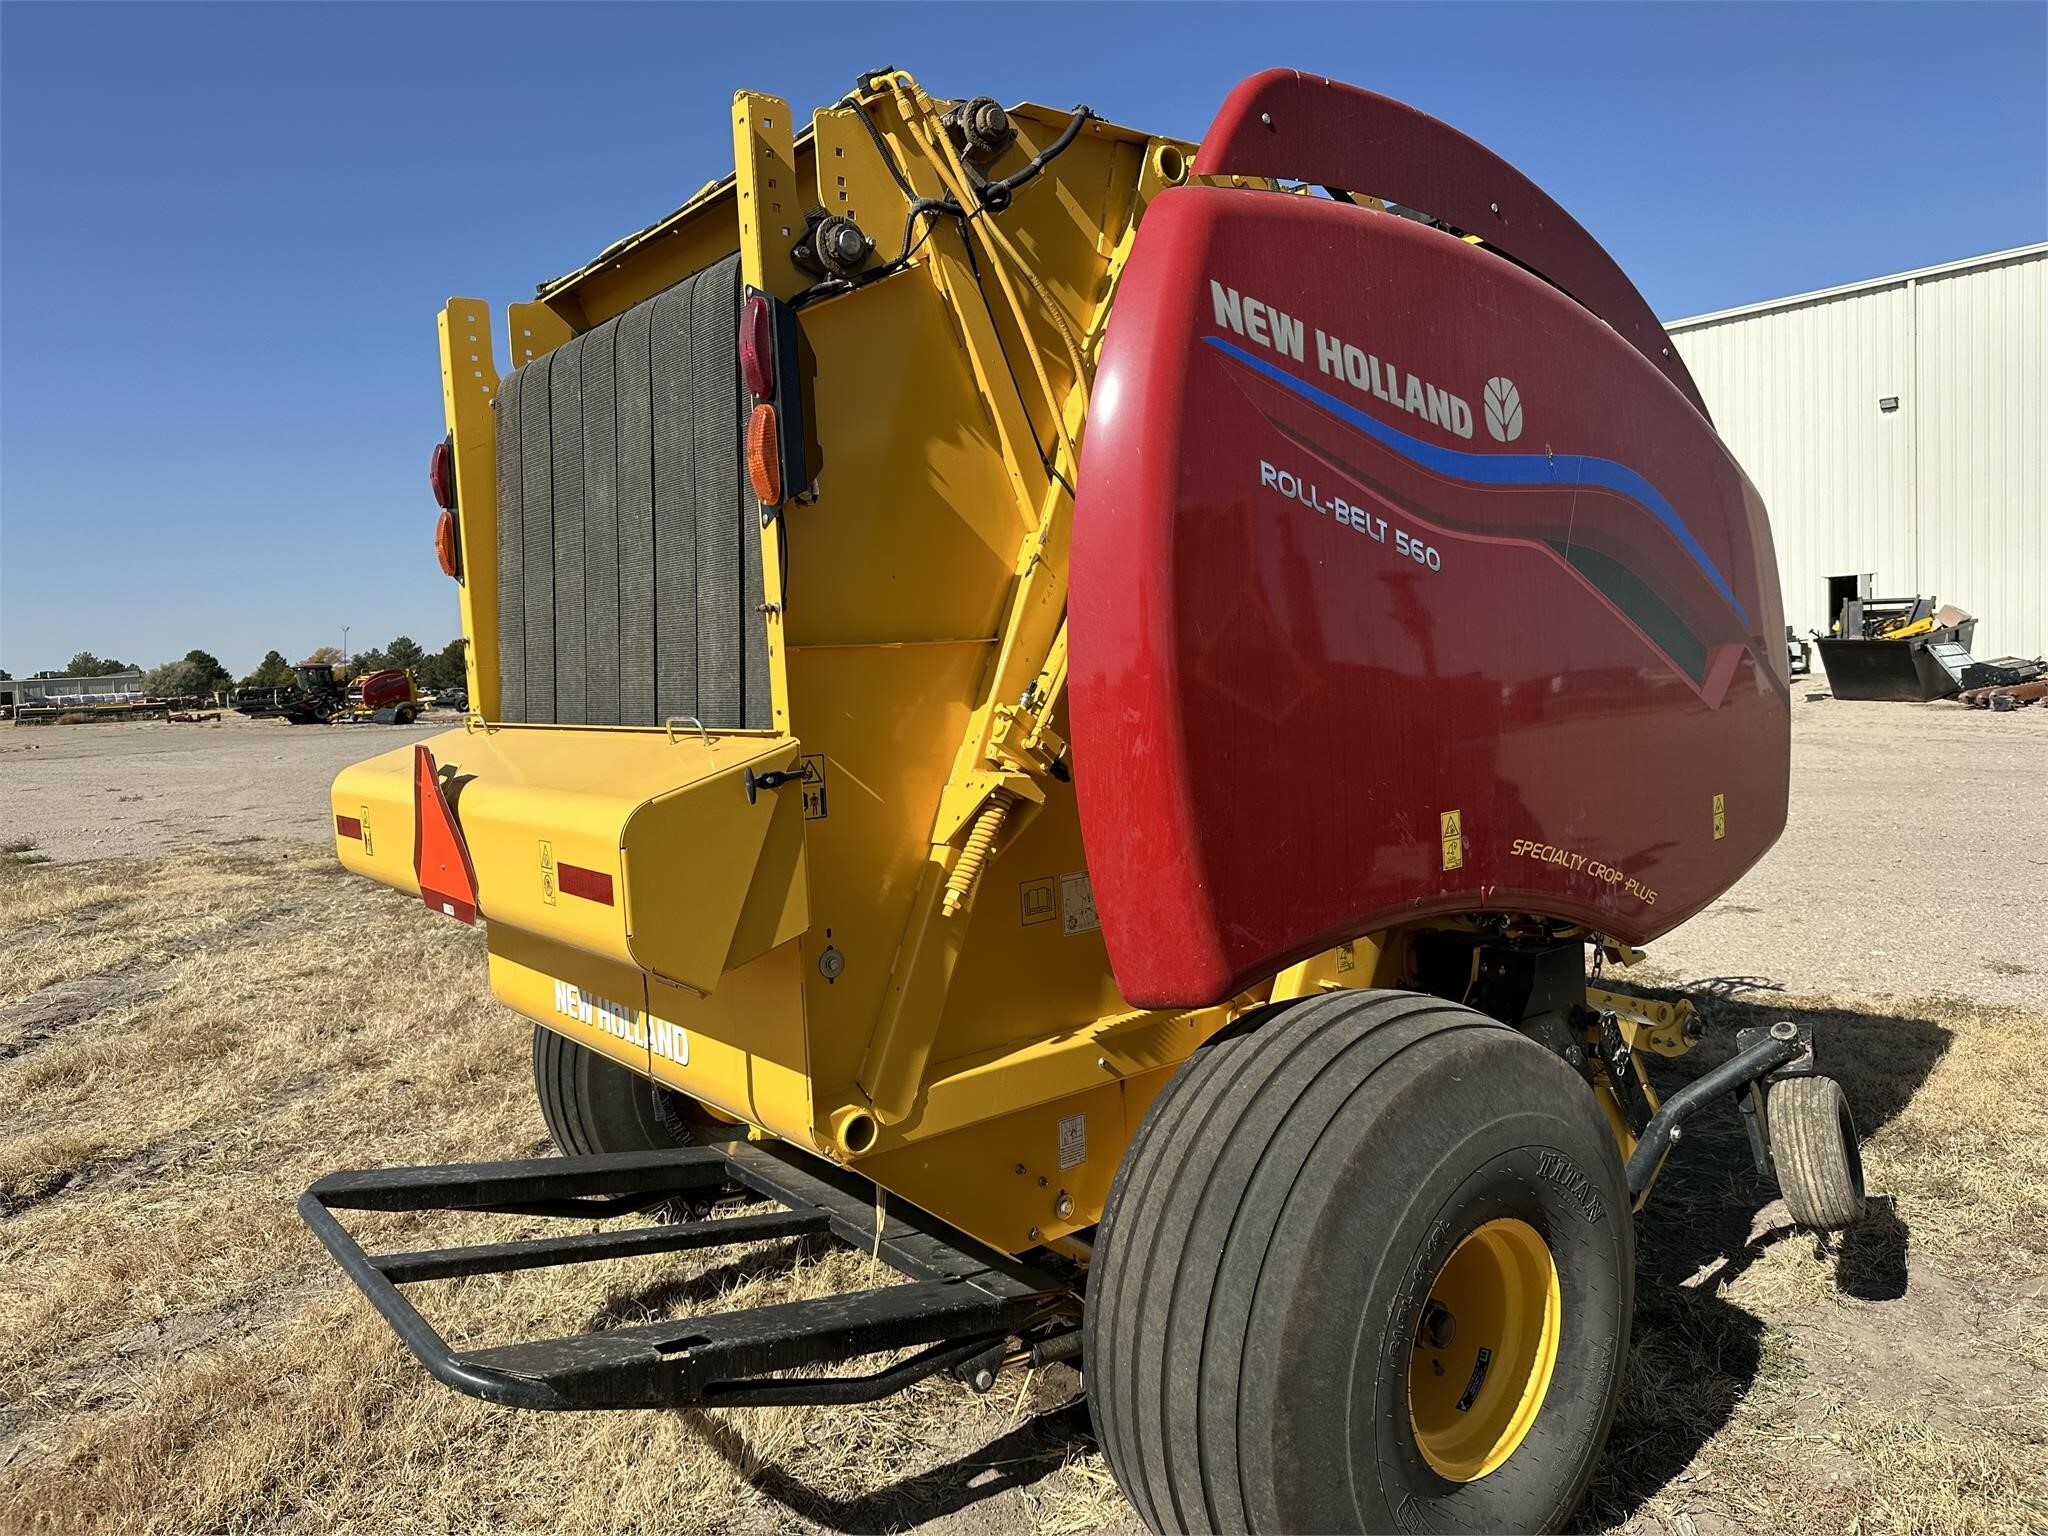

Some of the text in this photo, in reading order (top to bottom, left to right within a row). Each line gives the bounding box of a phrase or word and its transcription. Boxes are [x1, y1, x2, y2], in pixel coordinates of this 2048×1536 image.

[1210, 279, 1473, 440] NEW HOLLAND
[1260, 460, 1441, 572] ROLL-BELT 560
[1510, 839, 1587, 871] SPECIALTY
[1587, 861, 1623, 885] CROP
[554, 978, 689, 1066] NEW HOLLAND
[1535, 1150, 1604, 1225] TITAN
